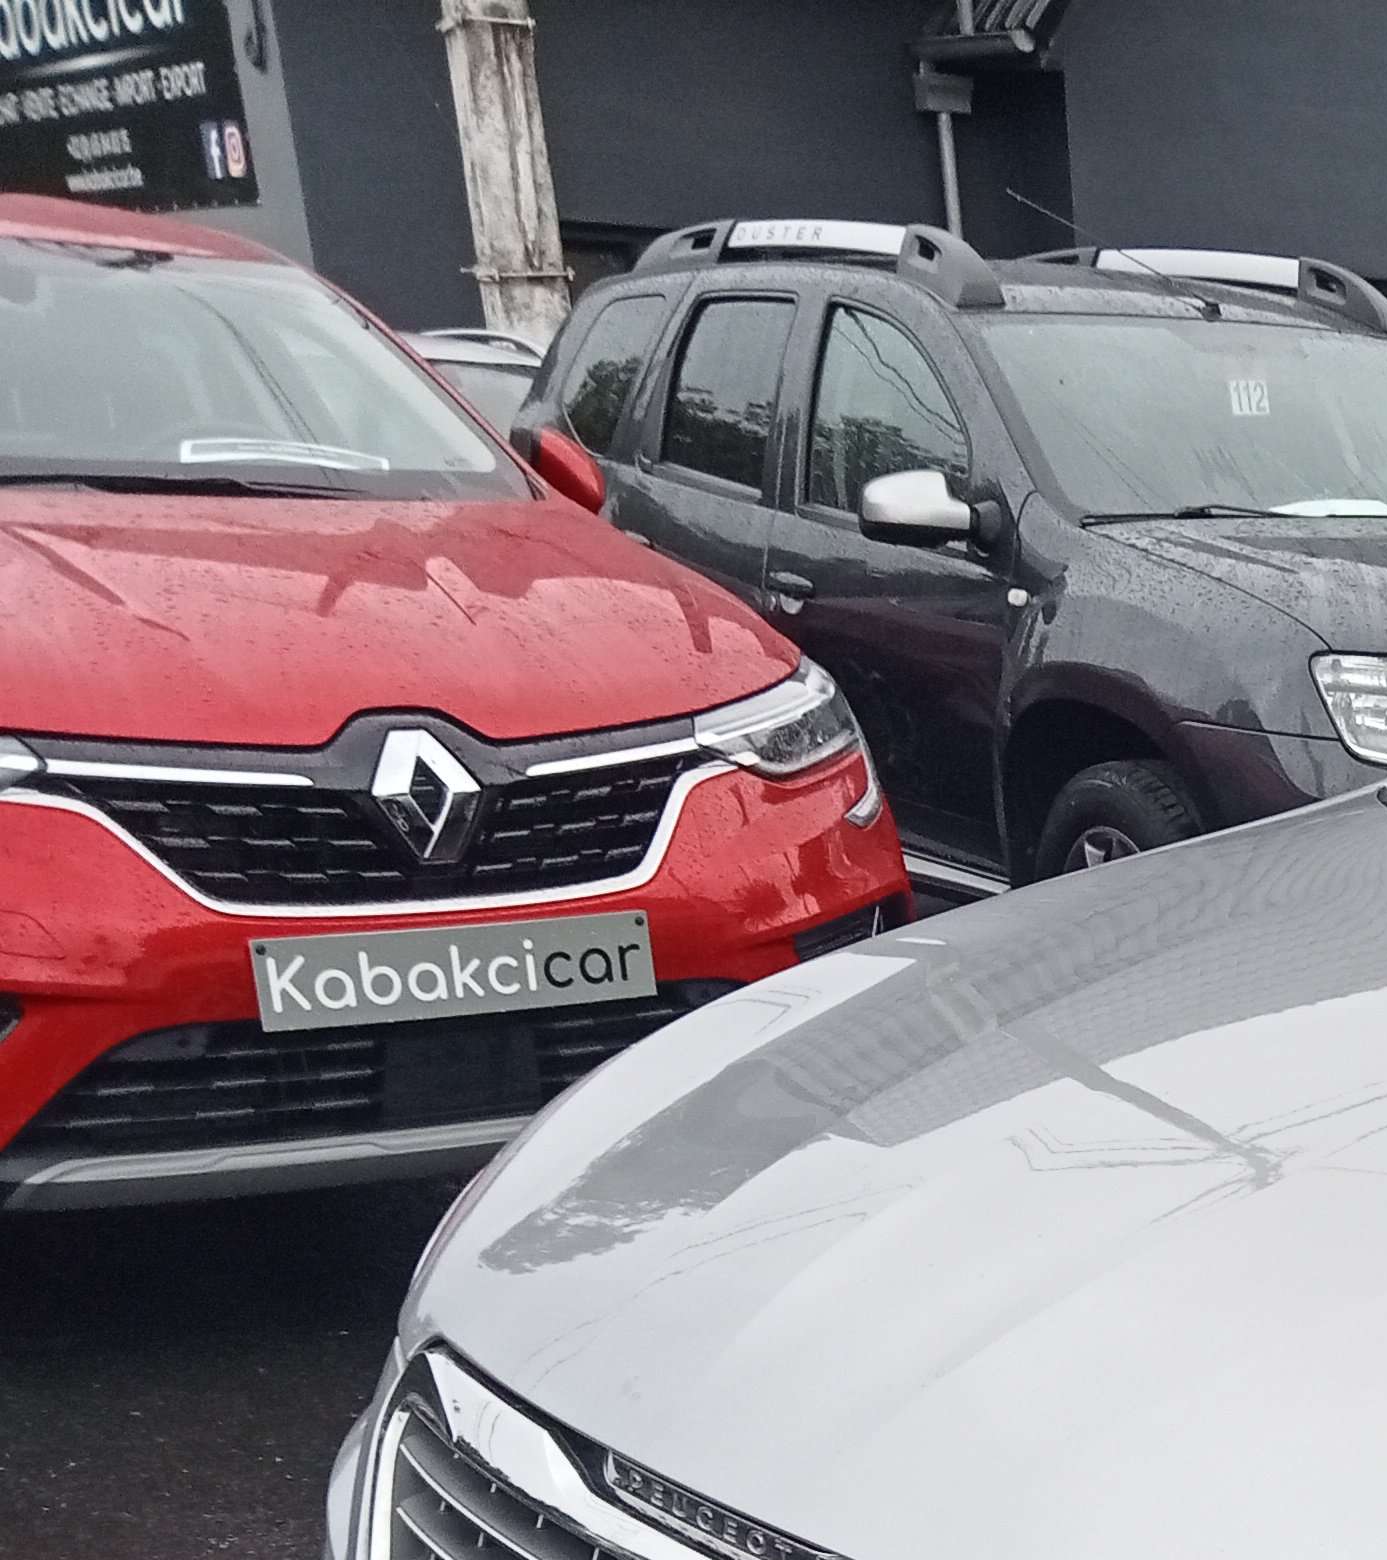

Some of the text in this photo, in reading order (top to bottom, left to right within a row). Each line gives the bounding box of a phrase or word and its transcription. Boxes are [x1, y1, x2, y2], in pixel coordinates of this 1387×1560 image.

[737, 226, 823, 241] DUSTER
[1233, 382, 1268, 413] 112
[265, 938, 641, 1014] Kabakcicar
